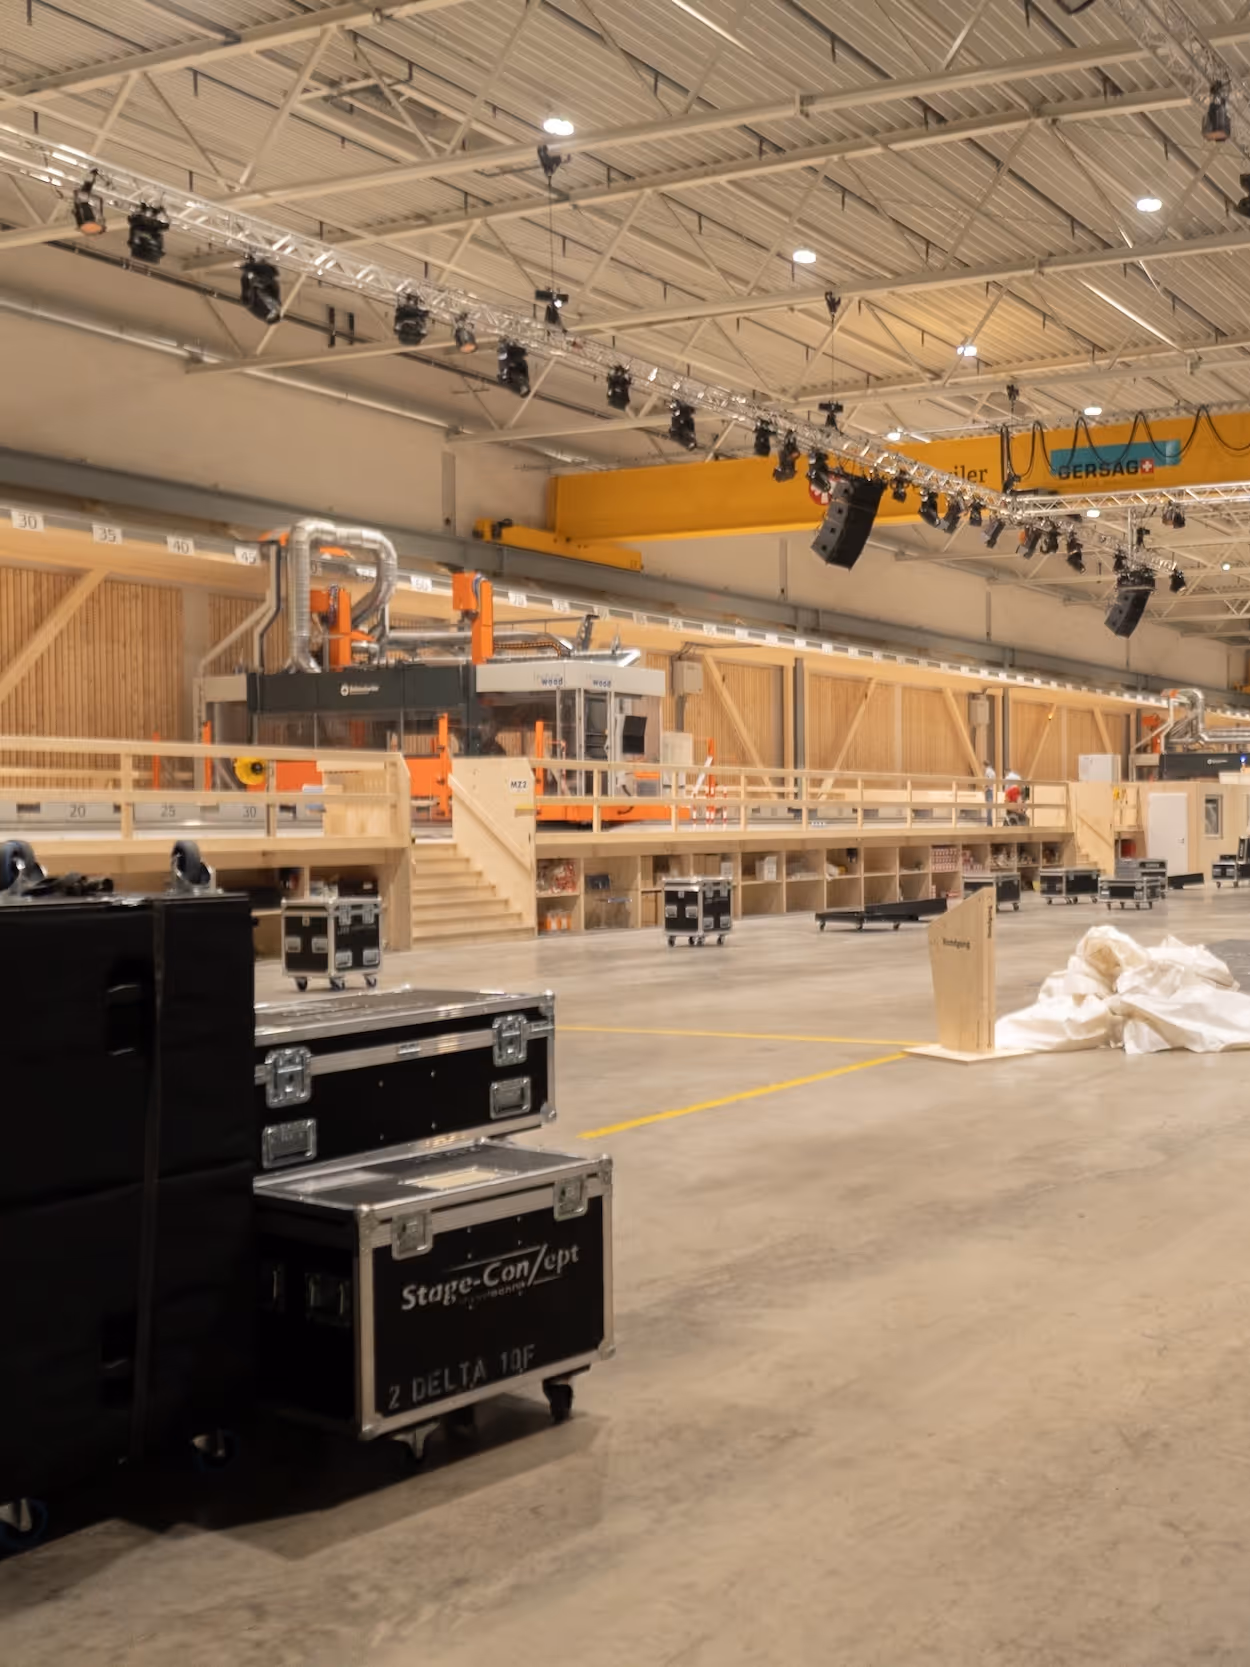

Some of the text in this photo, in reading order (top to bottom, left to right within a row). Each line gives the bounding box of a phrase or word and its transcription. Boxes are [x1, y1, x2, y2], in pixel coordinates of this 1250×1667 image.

[1058, 460, 1139, 480] GERSAG
[19, 514, 38, 529] 30
[99, 527, 117, 542] 35
[172, 540, 189, 554] 40
[241, 551, 257, 565] 45
[70, 804, 86, 818] 20
[161, 804, 176, 818] 25
[242, 806, 257, 819] 30
[389, 1385, 401, 1410] 2
[412, 1357, 487, 1403] DELTA
